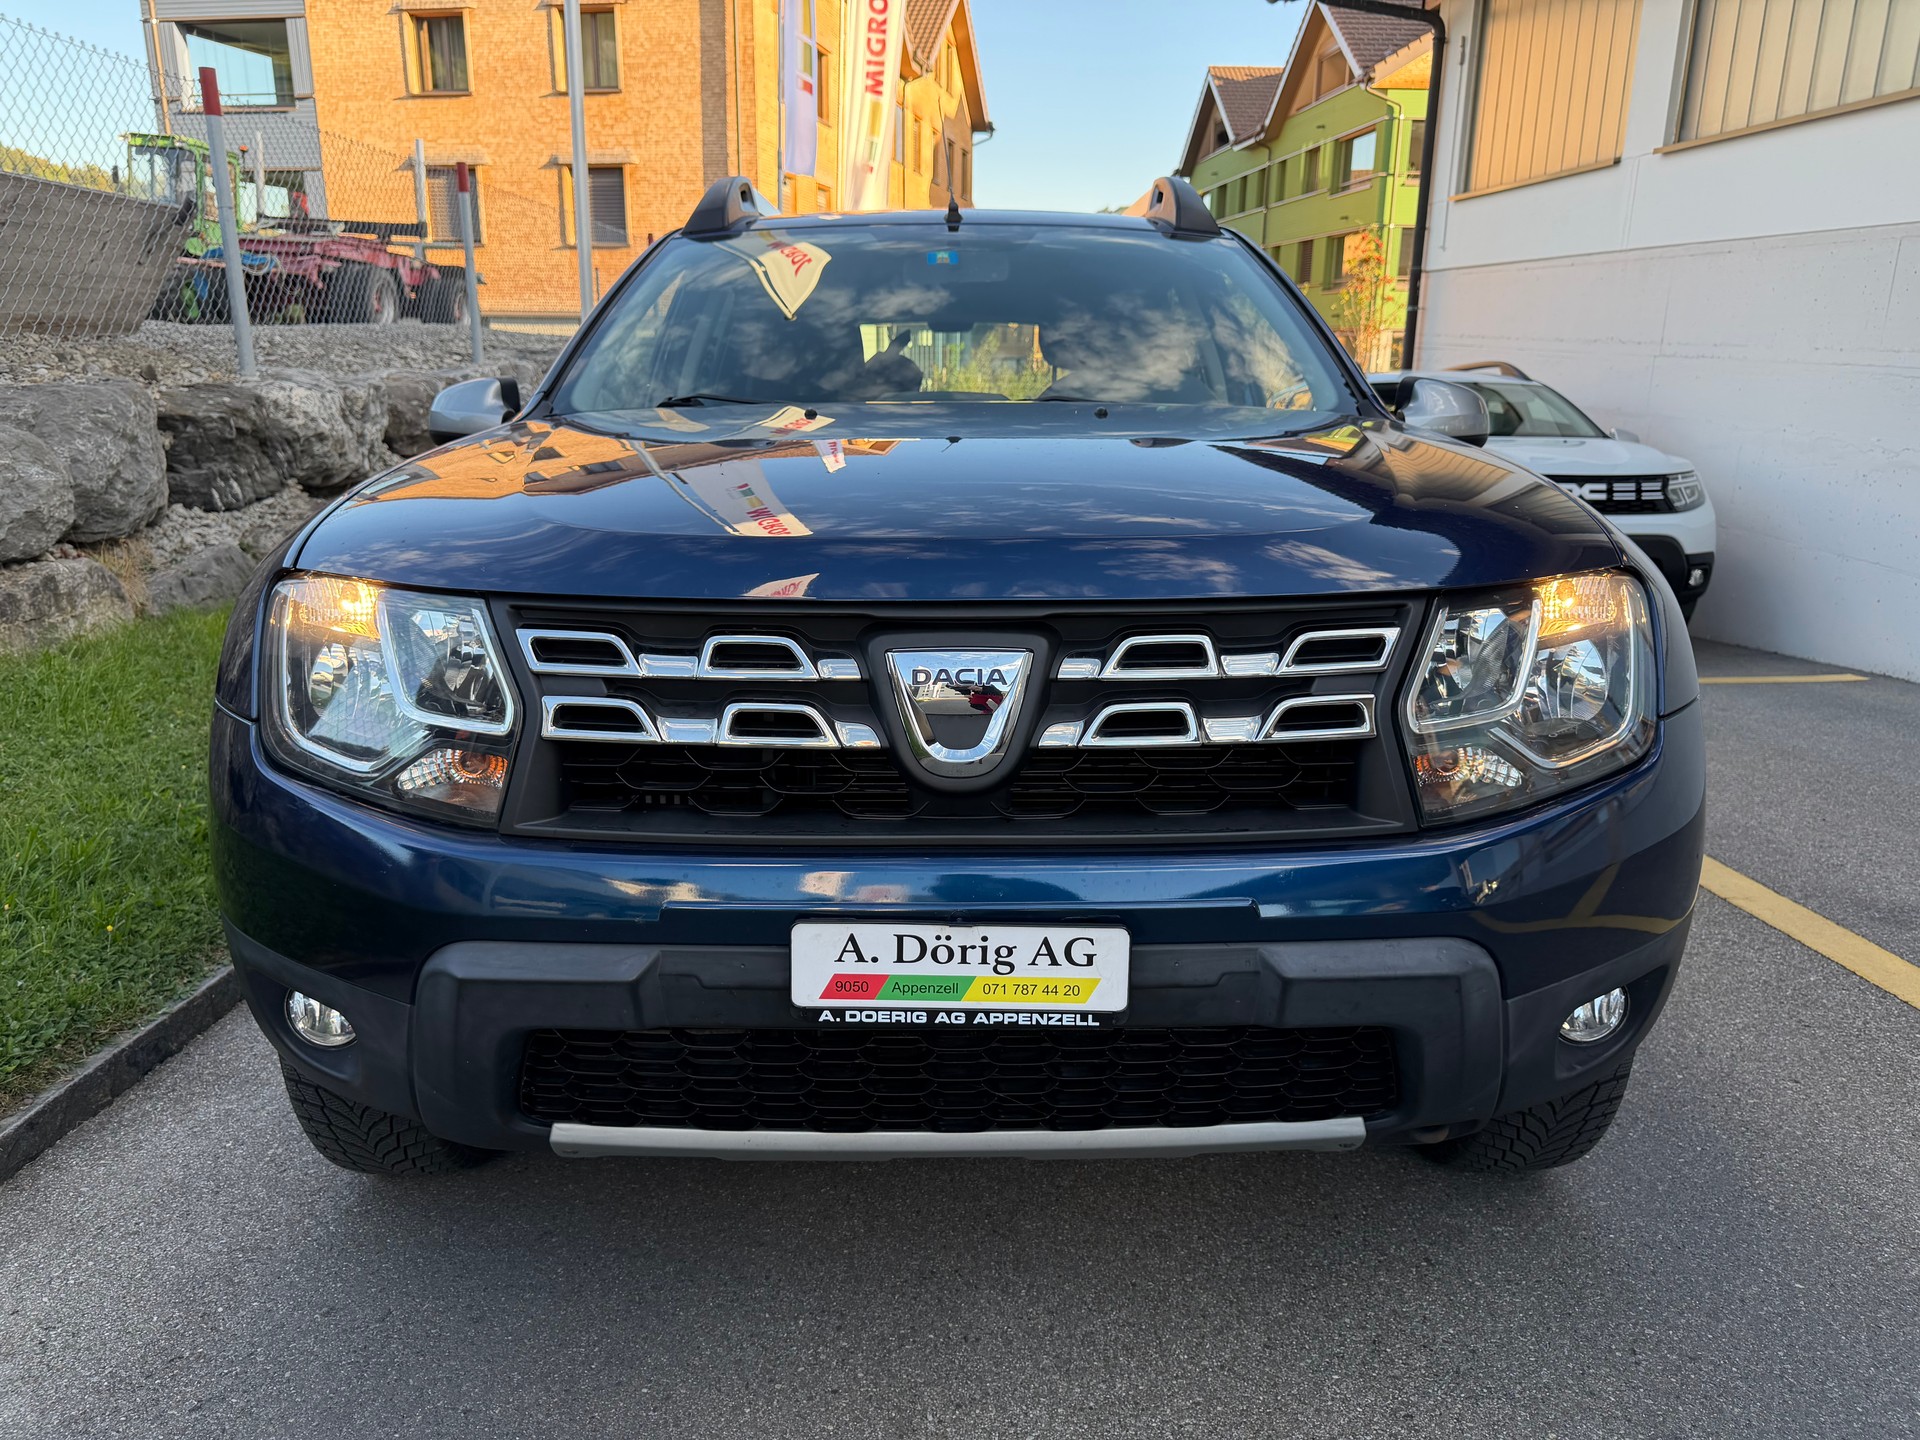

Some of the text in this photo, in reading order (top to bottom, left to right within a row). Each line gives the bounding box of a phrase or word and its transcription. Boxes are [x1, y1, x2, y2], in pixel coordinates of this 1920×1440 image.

[866, 0, 888, 97] MIGRO
[911, 668, 1008, 686] DACIA
[833, 932, 1097, 975] A. Dörig AG
[835, 980, 1081, 997] 9050 Appenzell 071 787 44 20
[818, 1010, 1100, 1026] A. DOERIG AG APPENZELL
